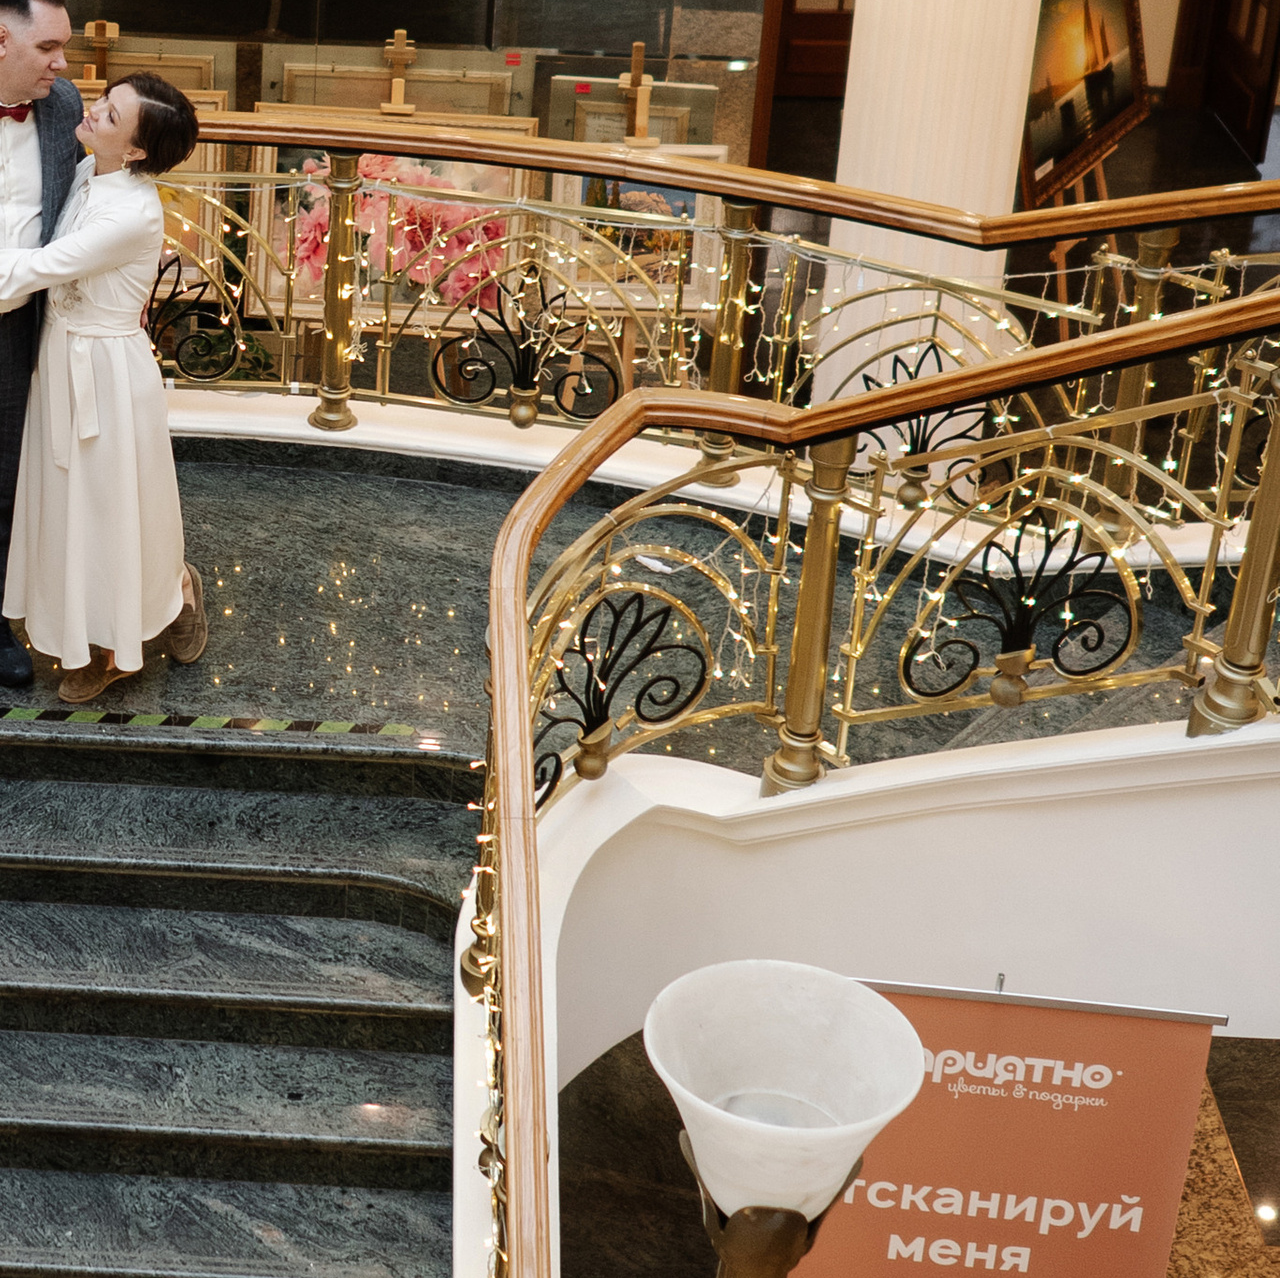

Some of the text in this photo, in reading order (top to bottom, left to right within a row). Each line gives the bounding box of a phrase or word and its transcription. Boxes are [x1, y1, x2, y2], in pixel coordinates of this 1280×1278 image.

[947, 1076, 1108, 1112] цветы & подарки
[843, 1178, 1144, 1239] тсканируй
[887, 1233, 1031, 1273] меня
